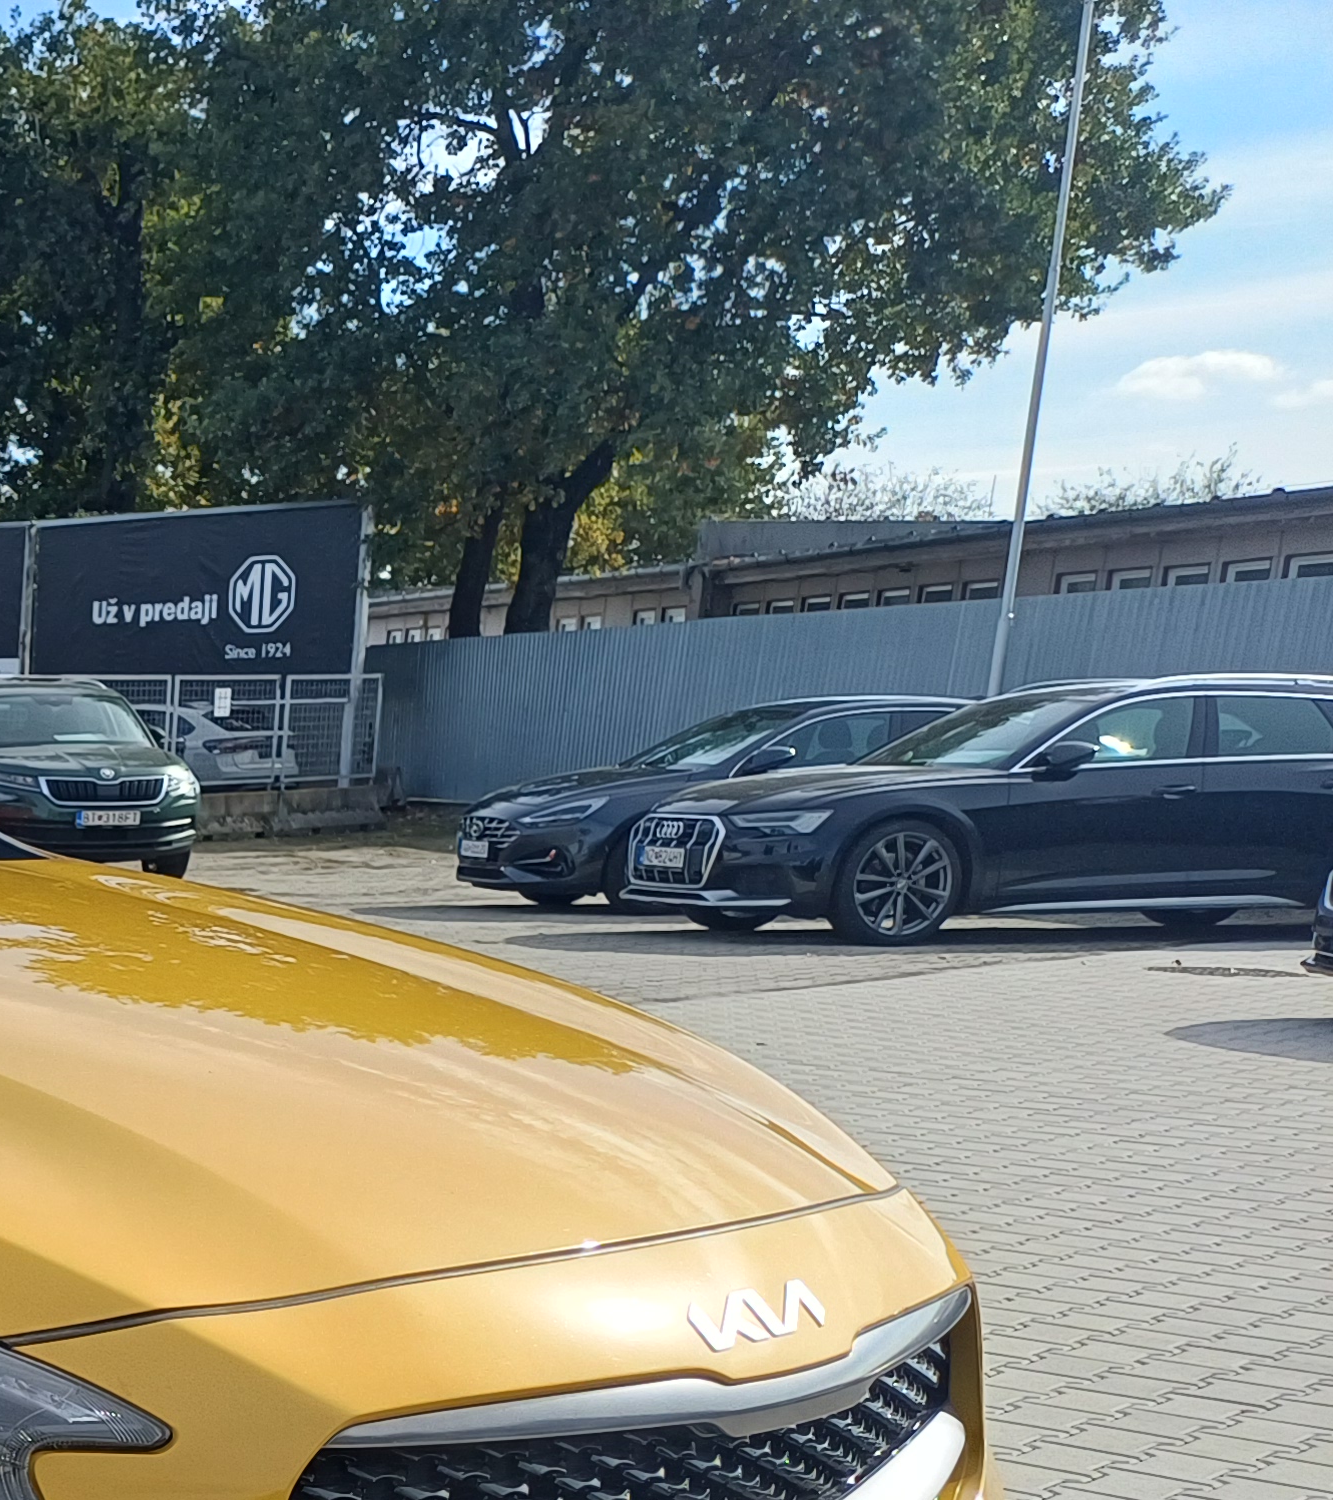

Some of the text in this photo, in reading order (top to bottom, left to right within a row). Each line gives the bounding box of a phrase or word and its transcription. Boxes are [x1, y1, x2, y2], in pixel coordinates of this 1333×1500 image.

[92, 594, 218, 627] Už v predaji
[234, 561, 290, 627] MG
[224, 642, 291, 660] Since 1924
